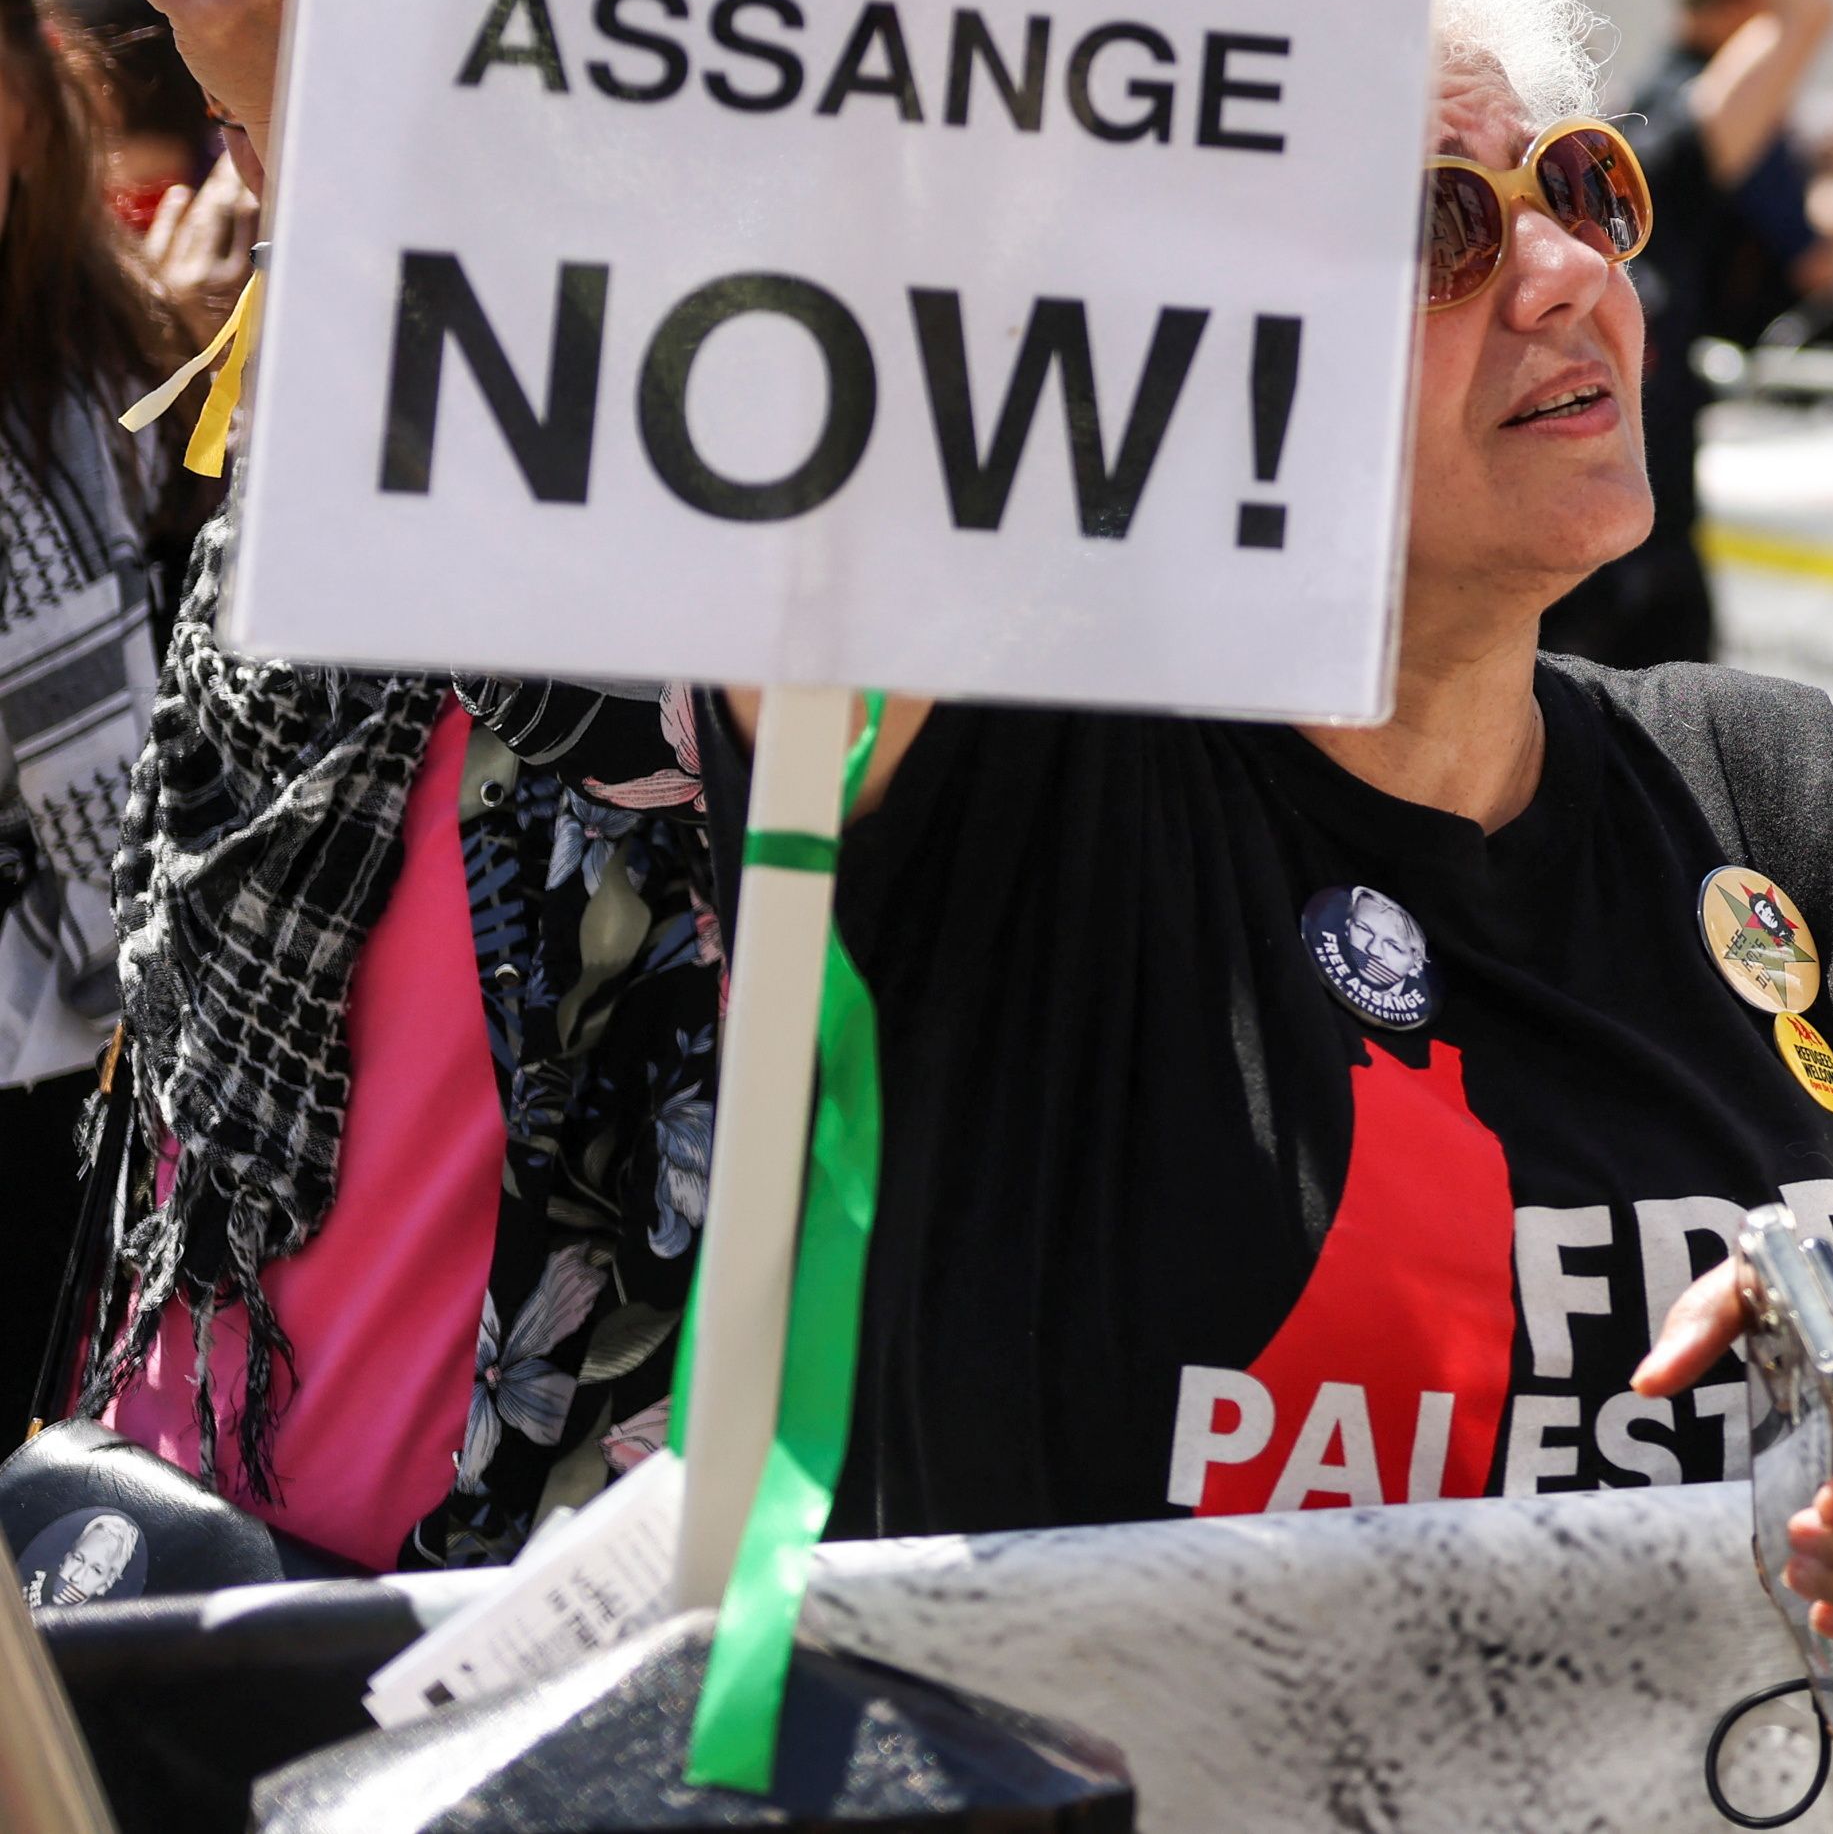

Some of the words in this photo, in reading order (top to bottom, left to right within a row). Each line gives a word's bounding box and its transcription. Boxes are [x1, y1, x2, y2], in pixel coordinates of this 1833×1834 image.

[379, 249, 1302, 550] NOW!
[1315, 947, 1327, 962] NO
[1346, 991, 1419, 1021] EXTRADITION
[1321, 931, 1350, 977] FREE
[1346, 977, 1426, 1011] ASSANGE
